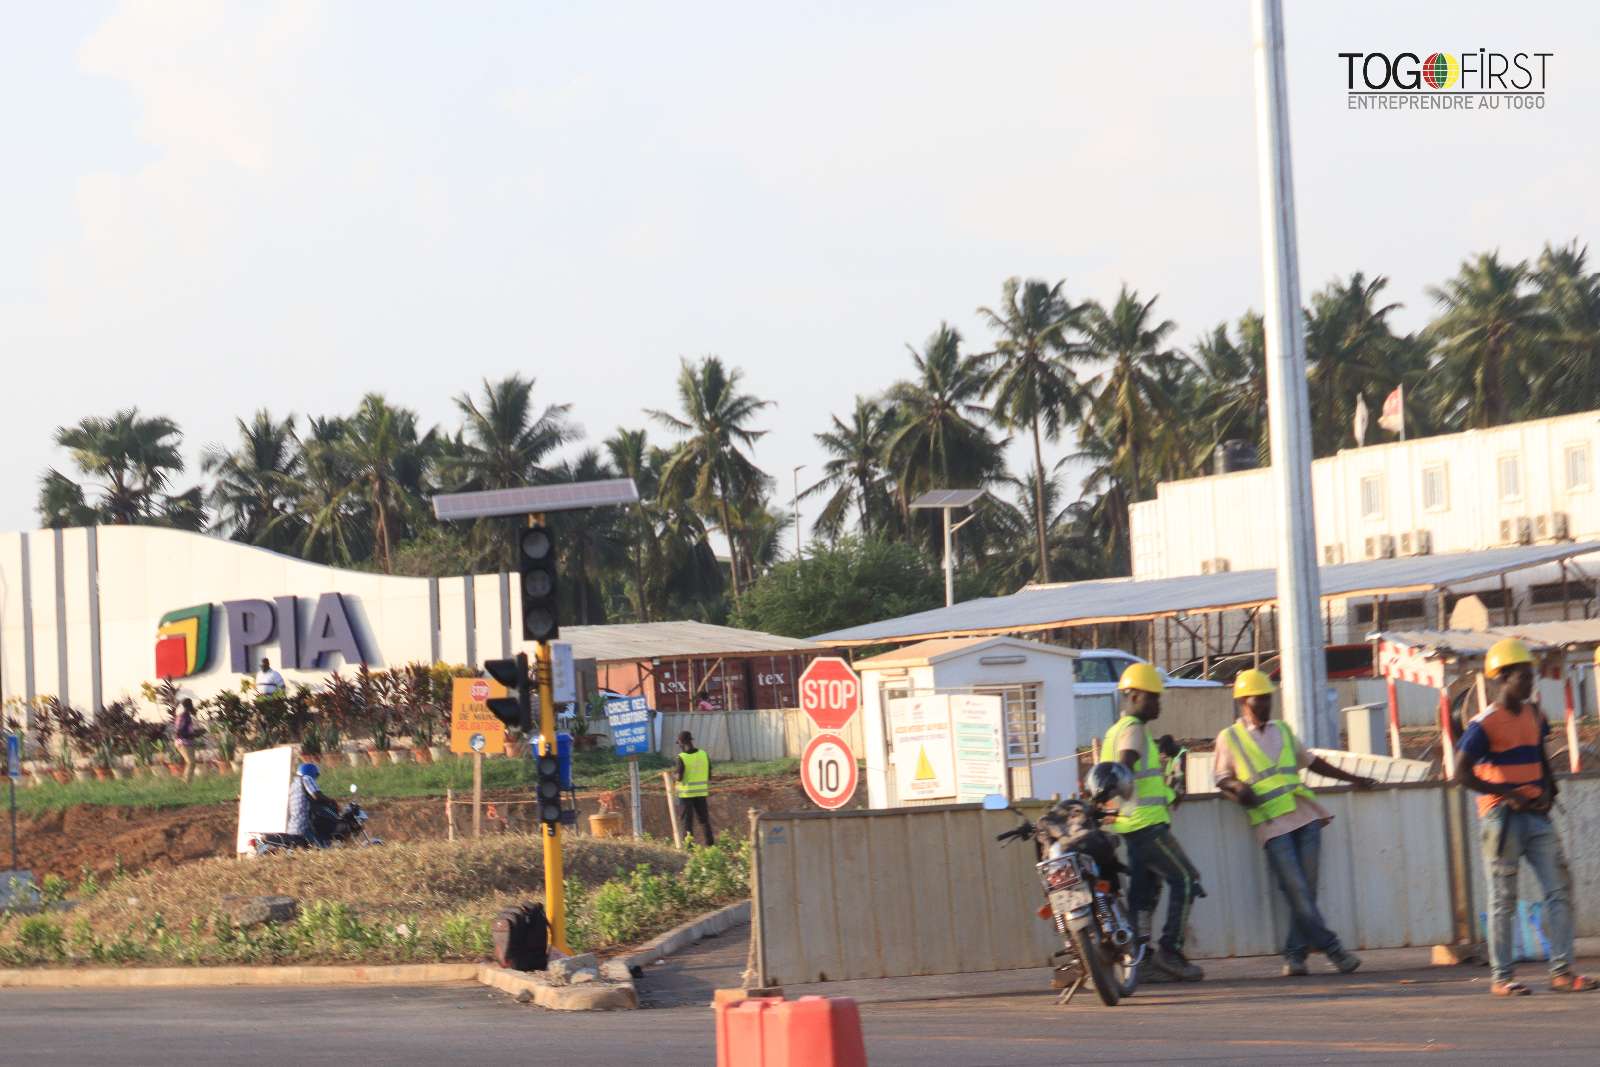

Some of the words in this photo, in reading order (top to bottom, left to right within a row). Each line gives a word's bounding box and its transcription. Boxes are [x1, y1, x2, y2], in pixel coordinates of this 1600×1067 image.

[222, 591, 369, 674] PIA
[758, 672, 785, 686] tex
[804, 679, 856, 709] STOP
[818, 759, 839, 793] 10
